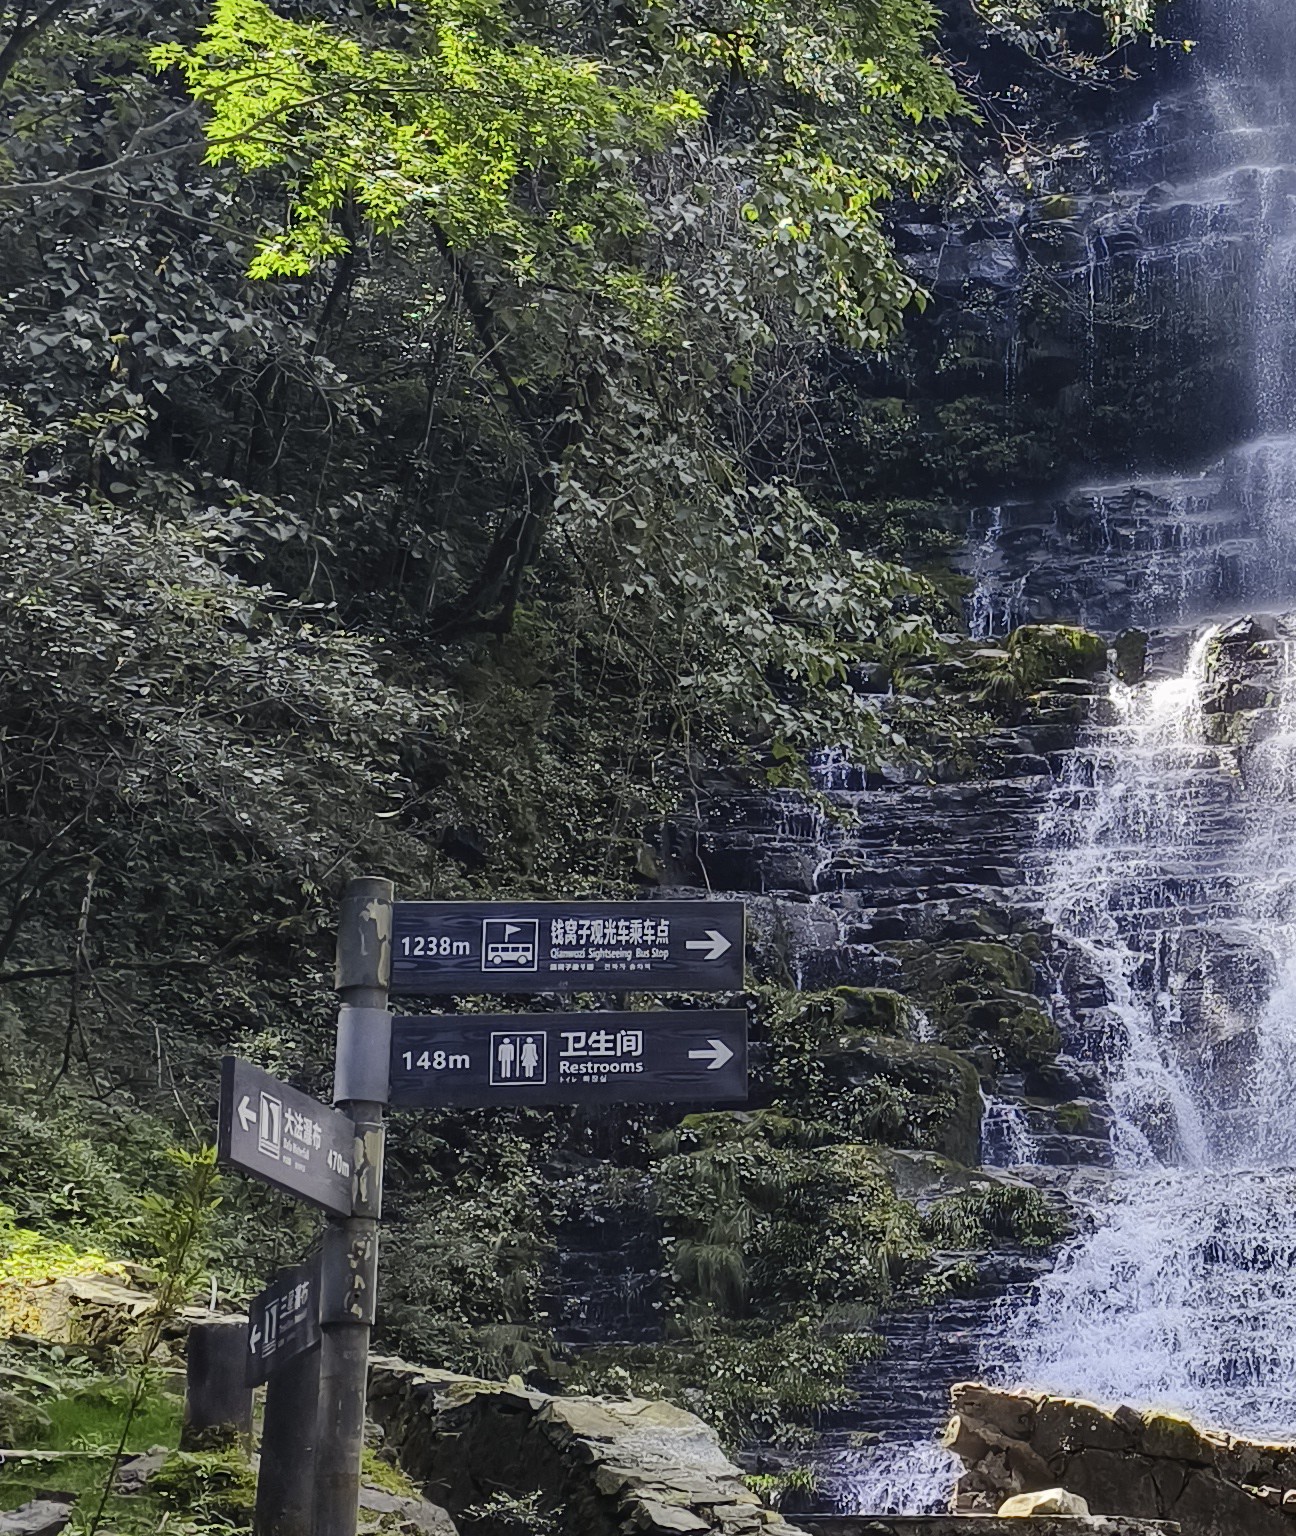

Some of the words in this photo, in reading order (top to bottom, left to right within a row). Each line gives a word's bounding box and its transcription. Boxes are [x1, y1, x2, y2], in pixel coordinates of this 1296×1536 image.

[401, 936, 470, 956] 1238m
[588, 947, 632, 961] Sightseeing
[635, 948, 650, 958] Bus
[651, 947, 669, 960] Stop
[559, 1030, 643, 1056] 卫生间
[402, 1050, 470, 1070] 148m
[559, 1061, 643, 1073] Restrooms
[327, 1149, 349, 1177] 470m
